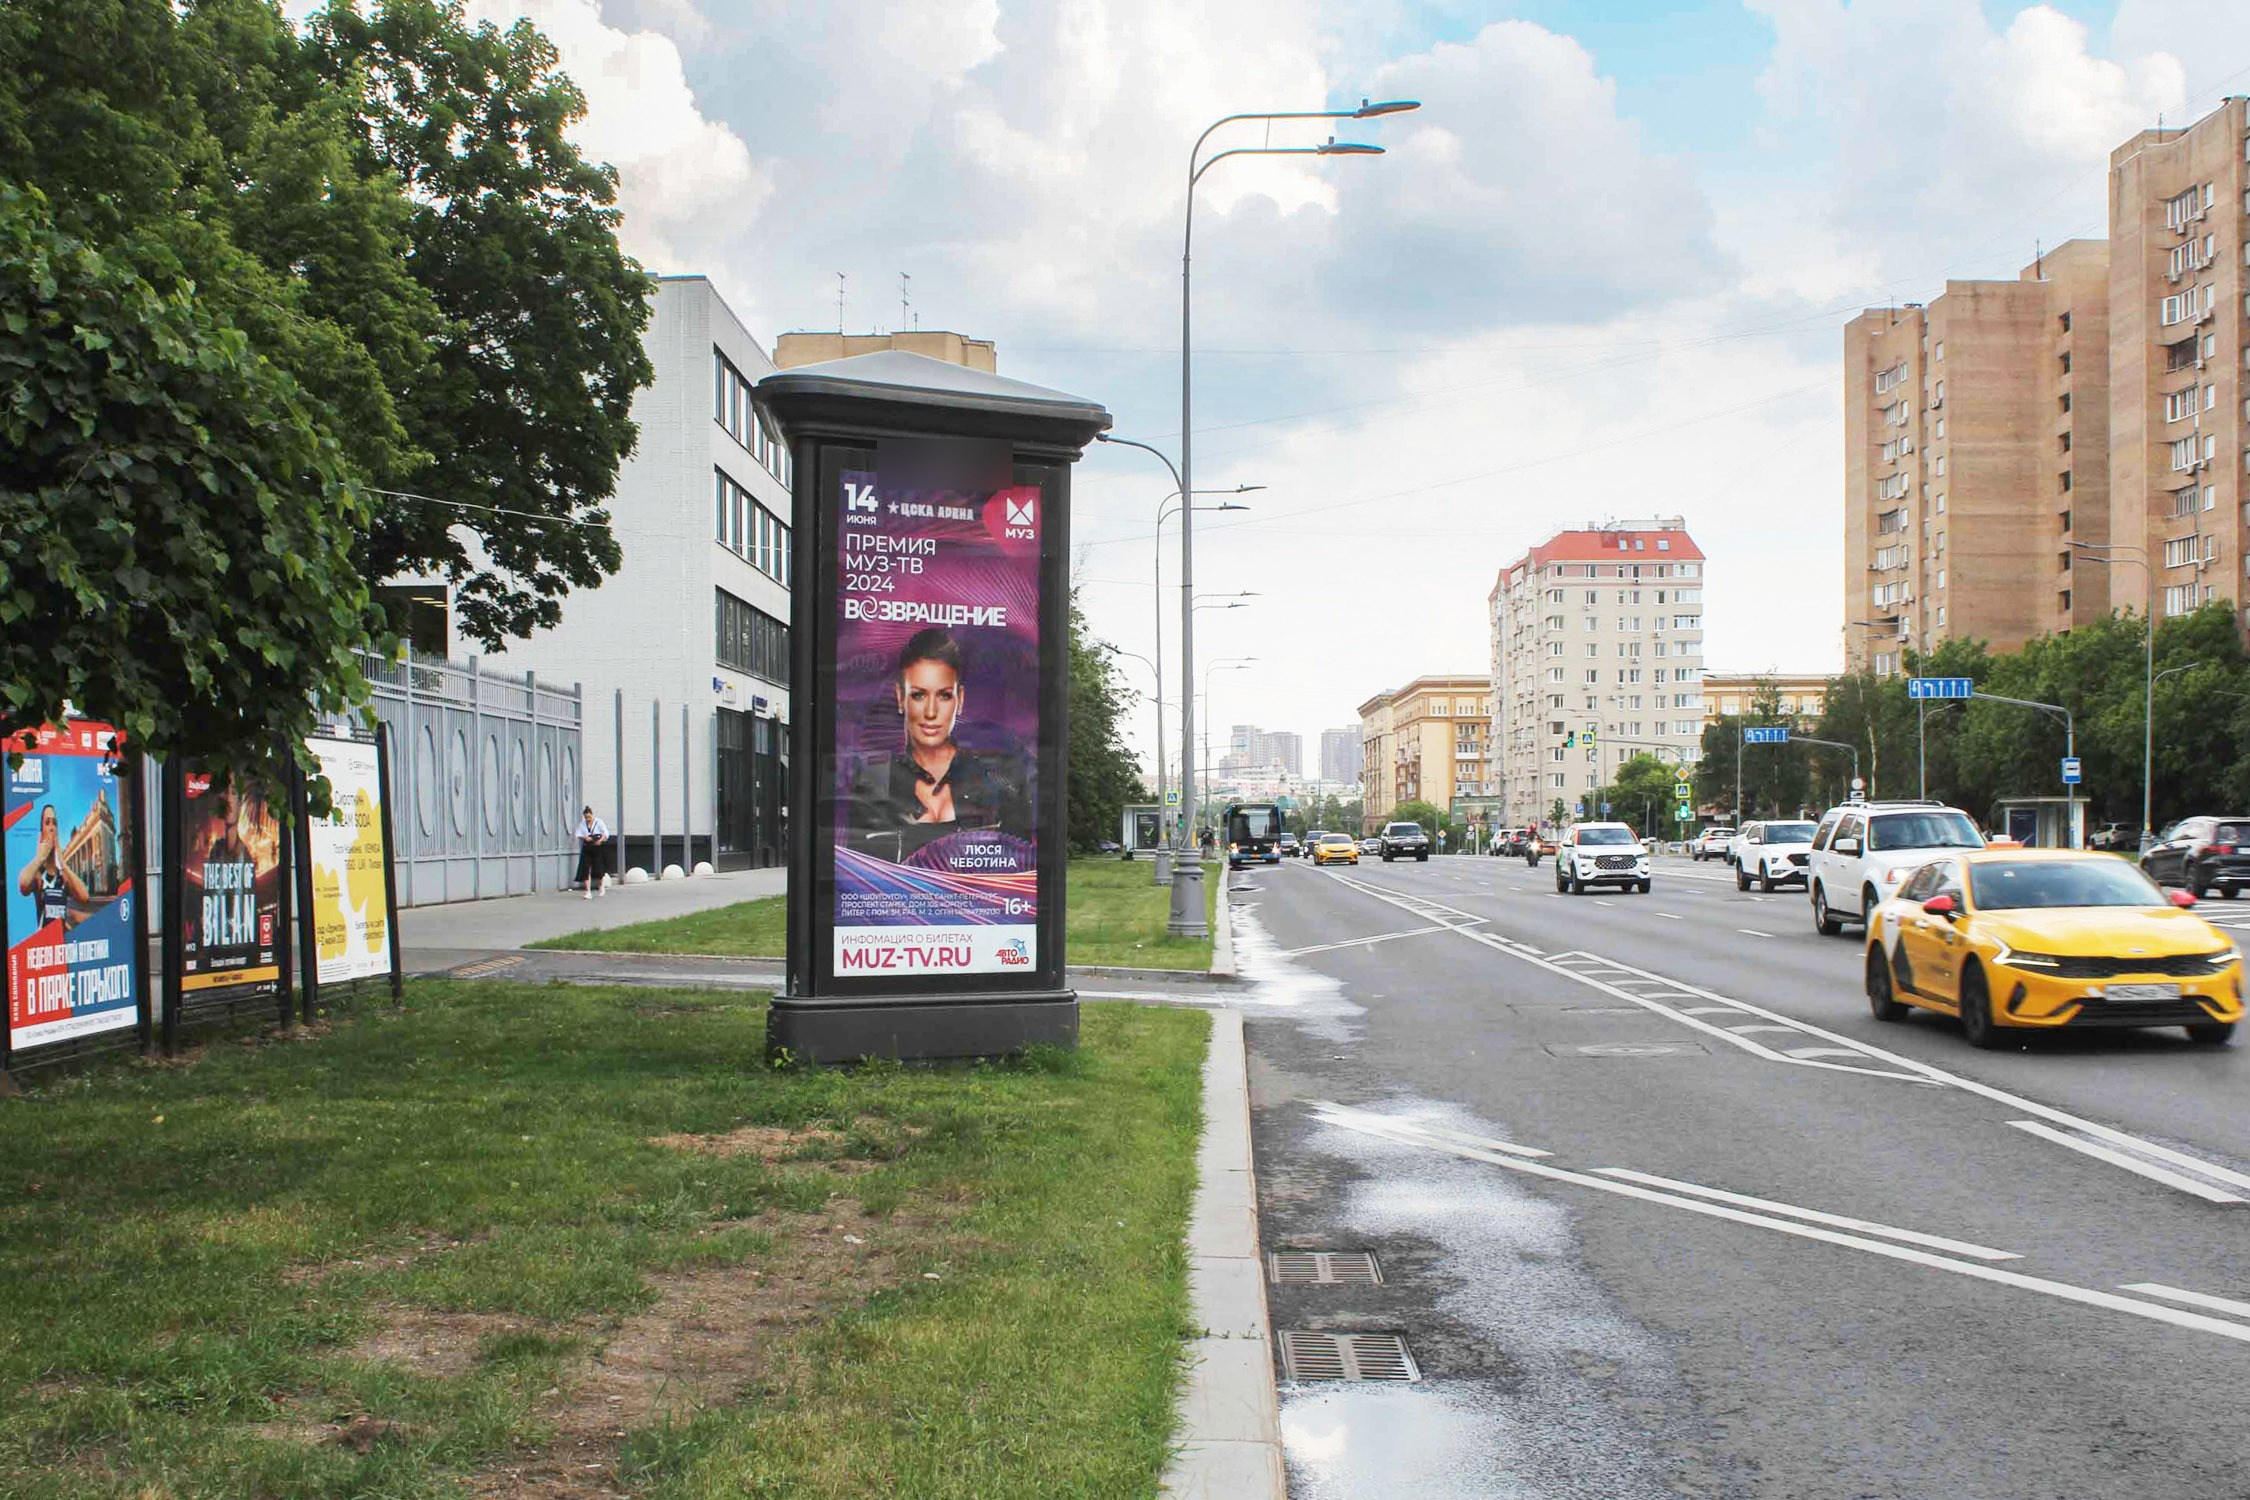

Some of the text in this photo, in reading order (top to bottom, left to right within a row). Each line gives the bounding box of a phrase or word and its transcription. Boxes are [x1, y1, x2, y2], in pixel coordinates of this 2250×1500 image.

[844, 483, 878, 512] 14
[901, 502, 975, 521] ЦСКА АРЕНА
[1005, 528, 1035, 540] МУЗ
[846, 533, 936, 555] ПРЕМИЯ
[846, 554, 923, 574] МУЗ-ТВ
[846, 574, 895, 592] 2024
[844, 596, 1007, 627] ВОЗВРАЩЕНИЕ
[965, 844, 1002, 856] ЛЮСЯ
[950, 857, 1017, 868] ЧЕБОТИНА
[203, 863, 255, 890] THE BEST OF
[841, 893, 858, 901] ООО
[841, 901, 878, 909] ПРОСПЕКТ
[1003, 897, 1032, 916] 16+
[203, 894, 255, 947] BILAN
[842, 933, 973, 945] ИНФОМАЦИЯ О БИЛЕТАХ
[27, 945, 53, 970] НЕДЕЛЯ
[843, 946, 971, 968] MUZ-TV.RU
[1001, 956, 1029, 965] РАДИО
[28, 964, 130, 1015] В ПАРКЕ ГОРЬКОГО
